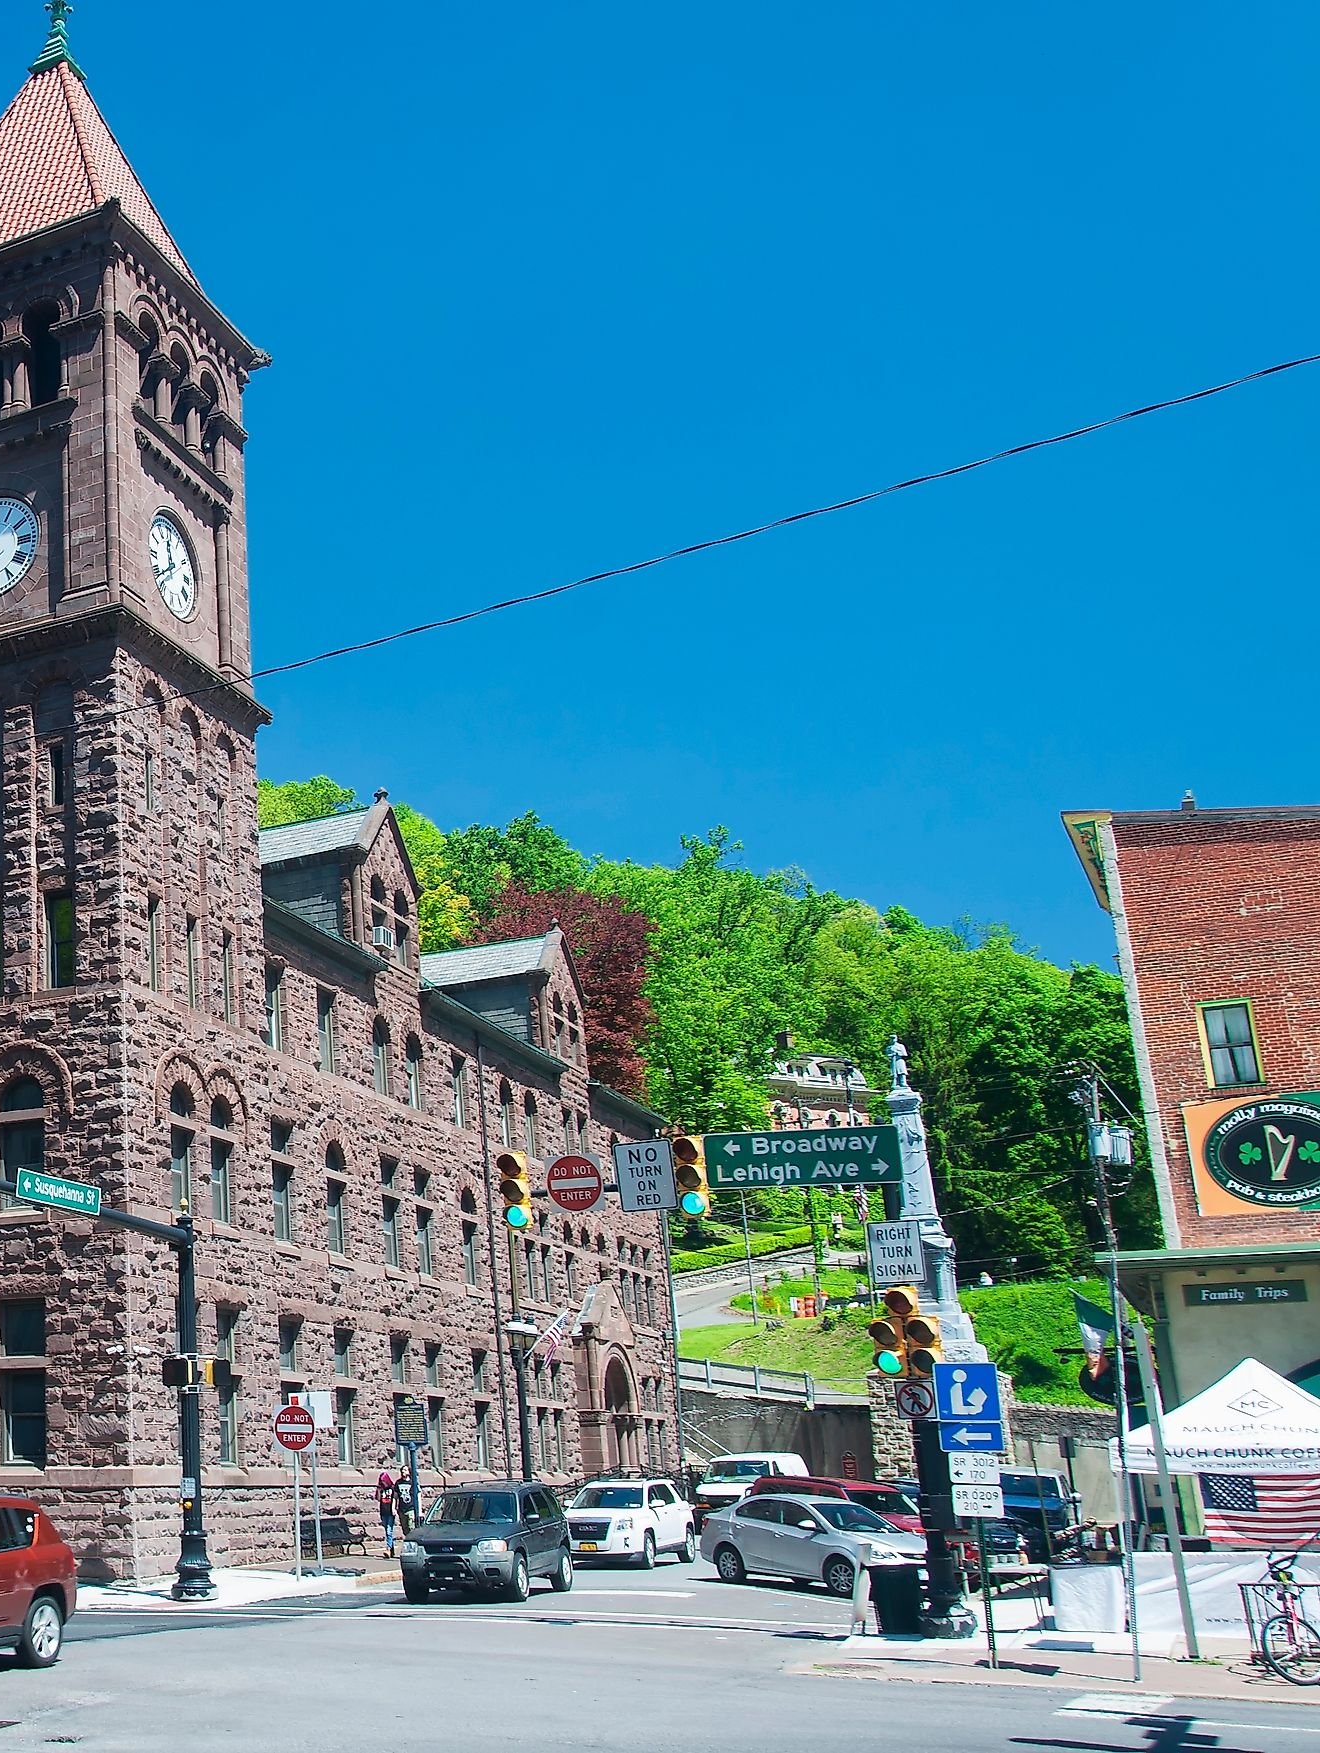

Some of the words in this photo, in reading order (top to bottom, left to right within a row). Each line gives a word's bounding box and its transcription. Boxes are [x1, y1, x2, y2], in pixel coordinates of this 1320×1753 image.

[1217, 1107, 1256, 1134] molly
[752, 1134, 877, 1155] Broadway
[628, 1147, 657, 1164] NO
[553, 1167, 567, 1177] DO
[572, 1165, 592, 1175] NOT
[628, 1165, 662, 1178] TURN
[716, 1162, 800, 1184] Lehigh
[811, 1161, 860, 1178] Ave
[34, 1177, 84, 1203] Susquehanna
[86, 1189, 96, 1206] St
[637, 1180, 657, 1191] ON
[1226, 1180, 1255, 1195] pub
[1255, 1191, 1266, 1200] &
[560, 1191, 592, 1201] ENTER
[636, 1194, 661, 1206] RED
[876, 1227, 911, 1240] RIGHT
[880, 1245, 913, 1258] TURN
[876, 1263, 921, 1276] SIGNAL
[1201, 1288, 1245, 1301] Family
[1255, 1287, 1289, 1299] Trips
[1240, 1400, 1269, 1409] MC
[280, 1414, 290, 1422] DO
[294, 1414, 309, 1422] NOT
[1183, 1423, 1254, 1433] MAUCH
[282, 1434, 307, 1442] ENTER
[1213, 1447, 1275, 1458] CHUNK
[953, 1457, 966, 1466] SR
[972, 1458, 995, 1467] 3012
[969, 1470, 986, 1479] 170
[955, 1490, 969, 1500] SR
[971, 1491, 999, 1500] 0209
[963, 1501, 978, 1511] 210
